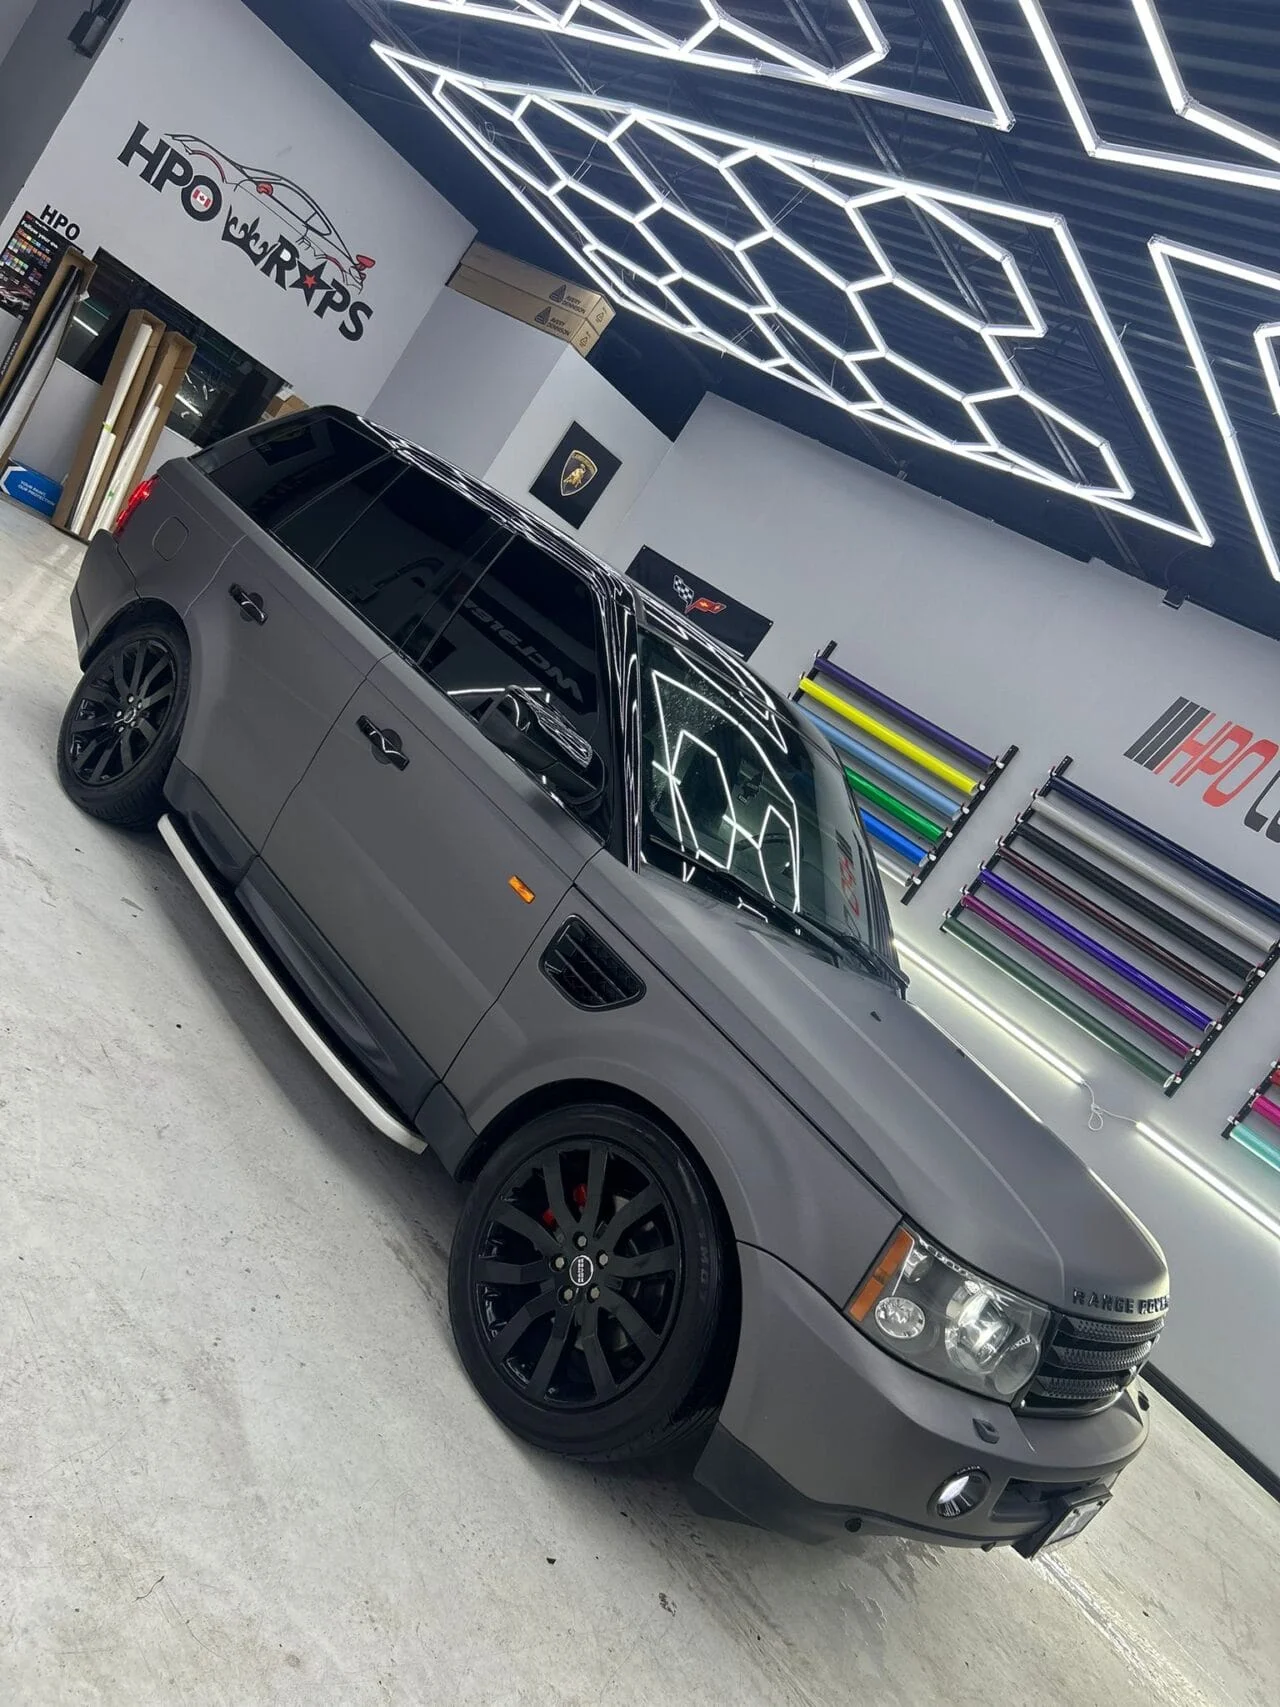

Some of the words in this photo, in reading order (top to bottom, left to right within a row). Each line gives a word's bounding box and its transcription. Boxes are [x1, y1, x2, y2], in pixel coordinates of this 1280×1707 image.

[117, 120, 222, 222] HPO
[40, 204, 80, 241] HPO
[1152, 712, 1280, 808] HPO
[1072, 1287, 1135, 1314] RANGE
